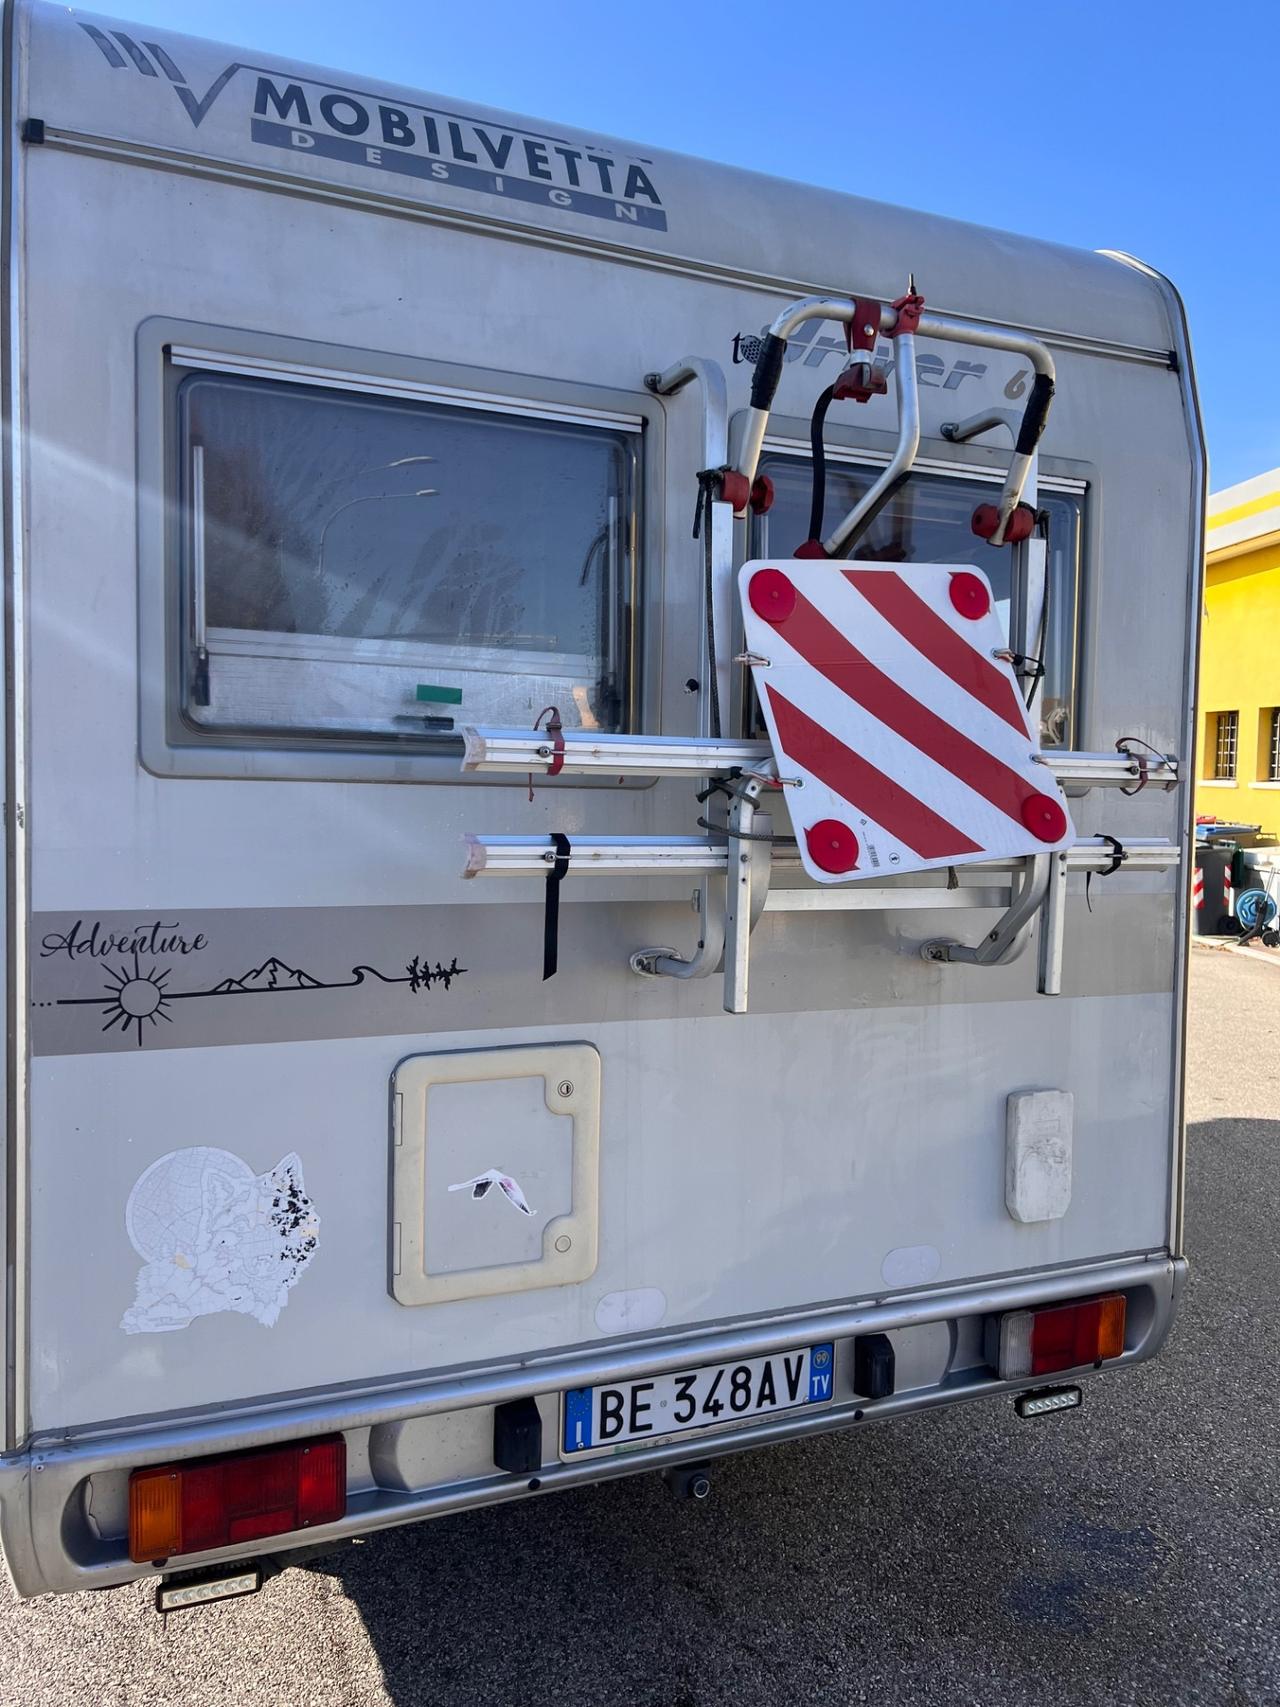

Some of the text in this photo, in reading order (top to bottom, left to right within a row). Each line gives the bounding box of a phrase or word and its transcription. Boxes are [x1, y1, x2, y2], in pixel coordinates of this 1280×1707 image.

[254, 77, 662, 205] MOBILVETTA
[291, 130, 638, 222] DESIGN
[39, 919, 209, 960] Adventure
[600, 1383, 654, 1440] BE
[673, 1354, 804, 1424] 348AV
[812, 1373, 830, 1396] TV
